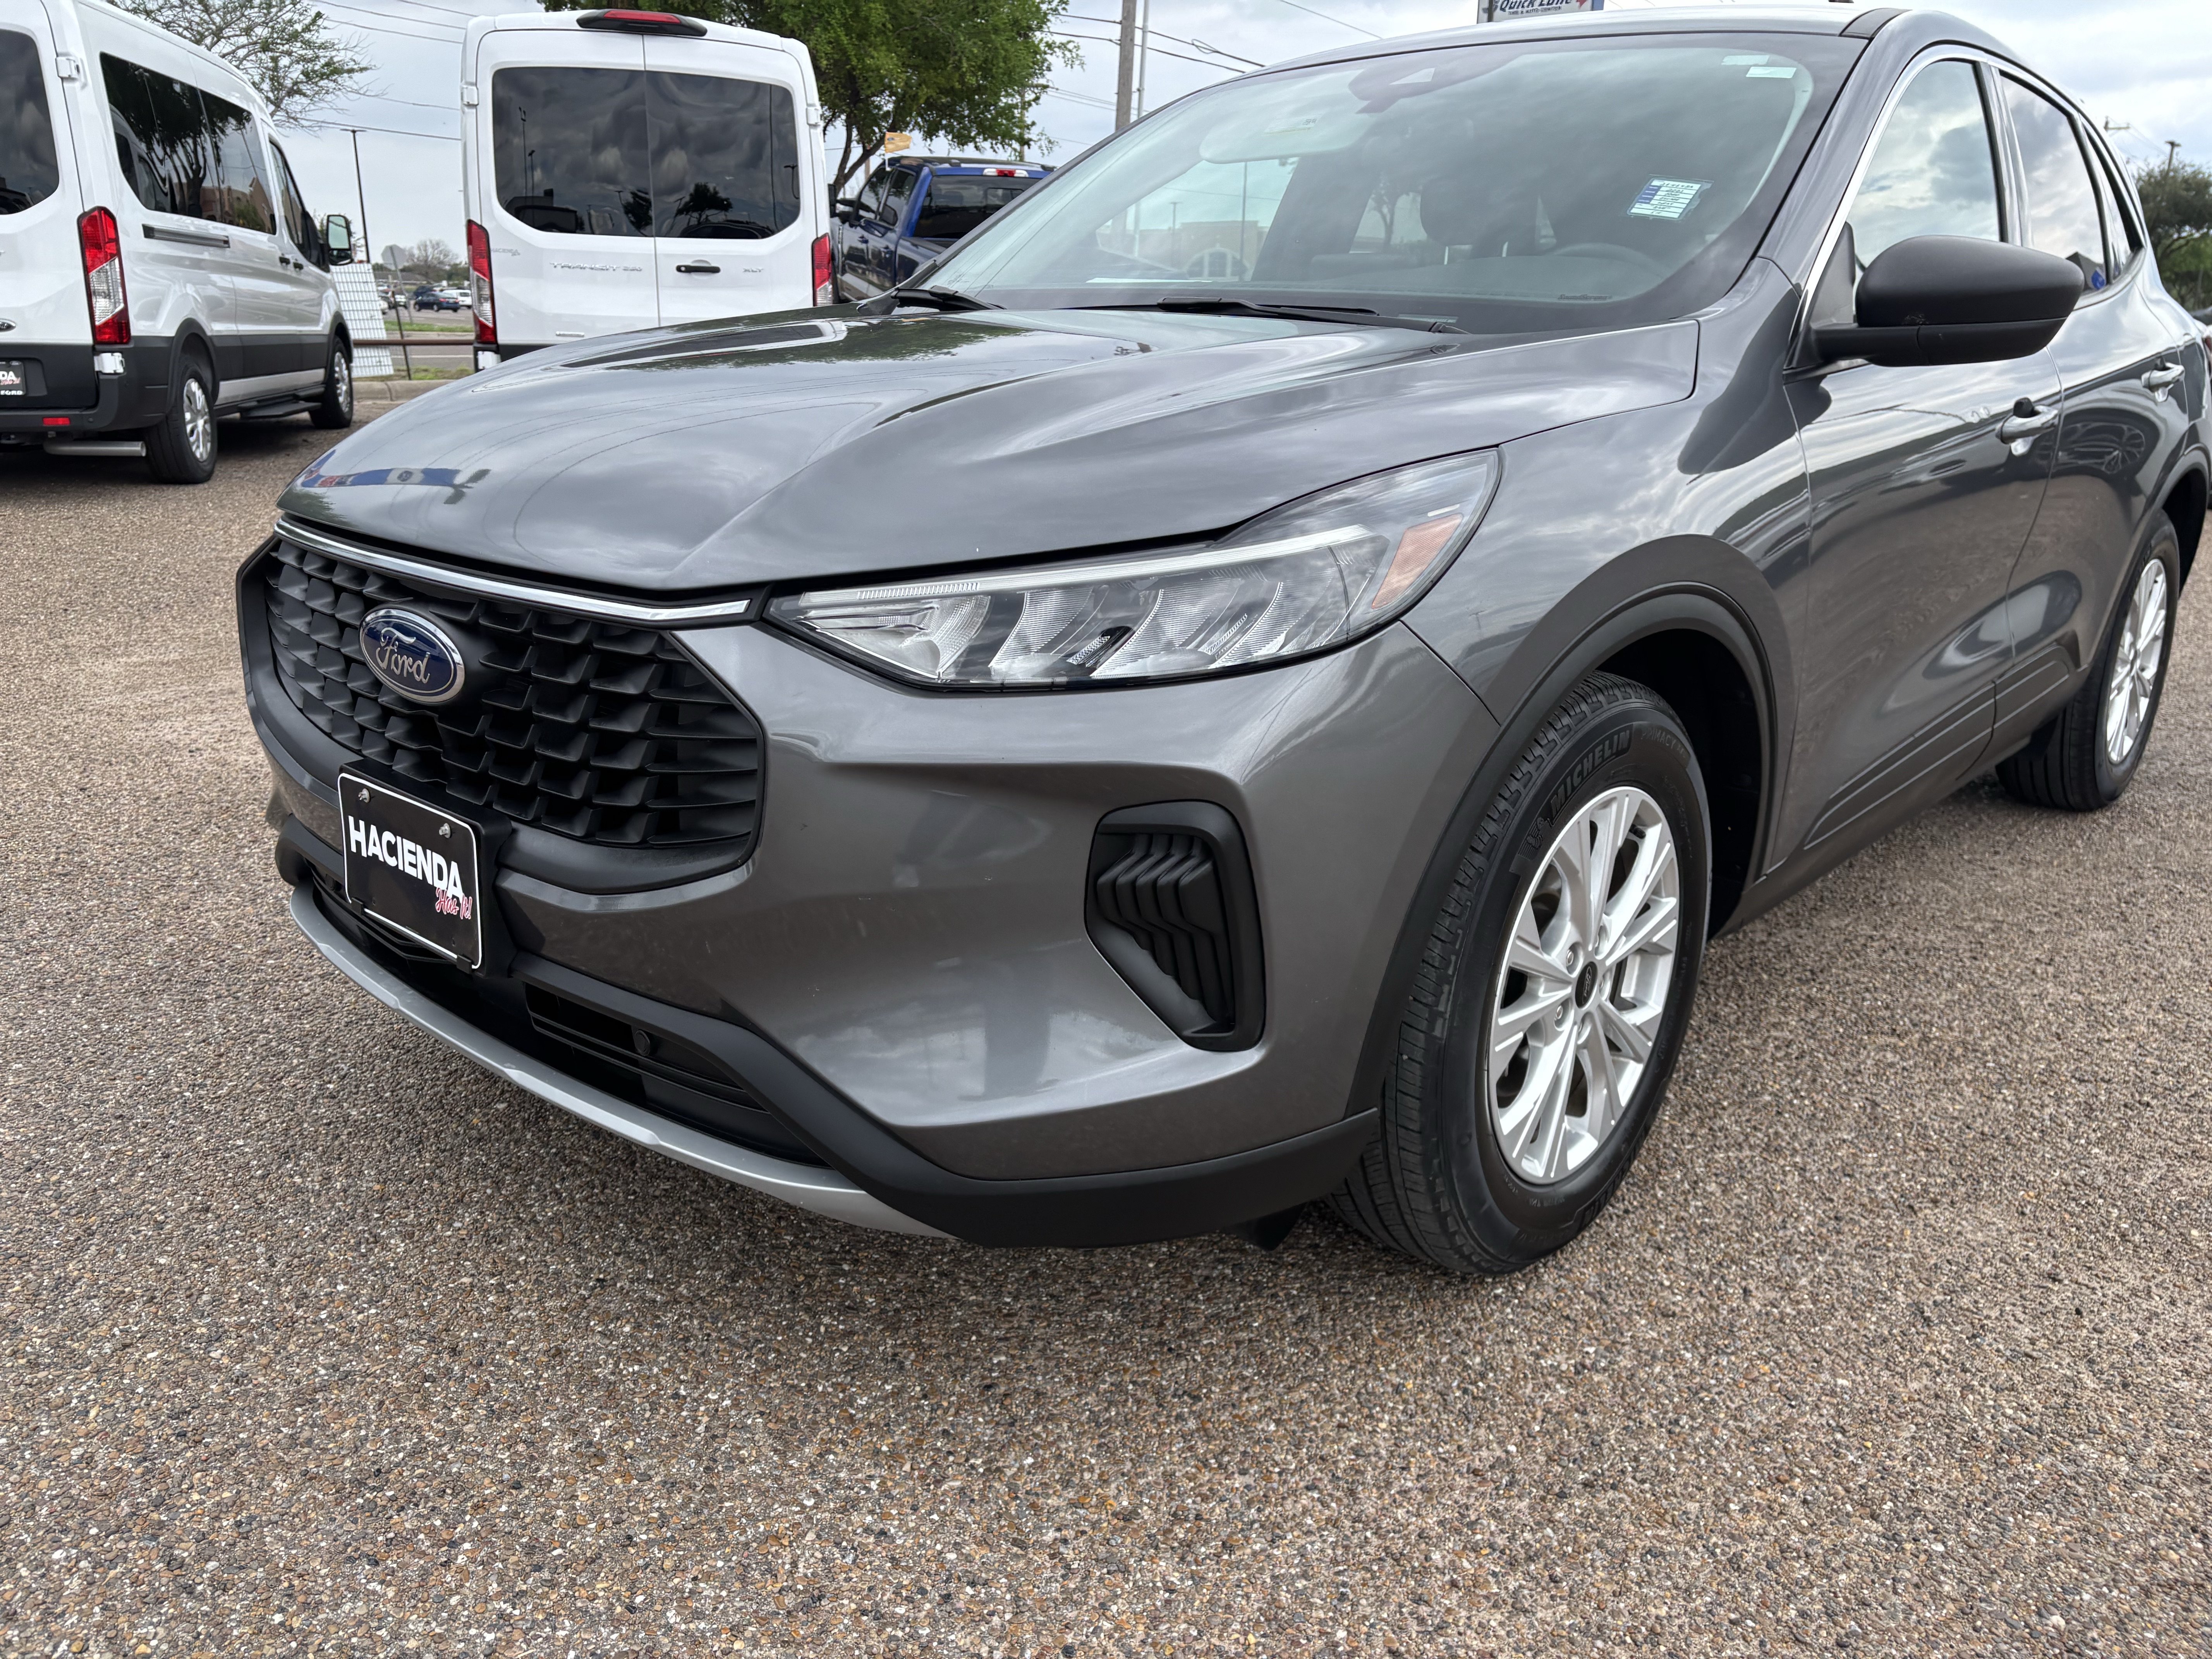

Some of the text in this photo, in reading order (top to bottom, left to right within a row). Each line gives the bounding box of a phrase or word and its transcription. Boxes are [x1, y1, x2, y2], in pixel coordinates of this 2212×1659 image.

[1500, 0, 1535, 12] Quick
[550, 263, 620, 271] TRANSIT
[376, 627, 430, 683] Ford
[1551, 730, 1630, 818] MICHELIN
[348, 815, 464, 903] HACIENDA
[435, 887, 459, 915] Has
